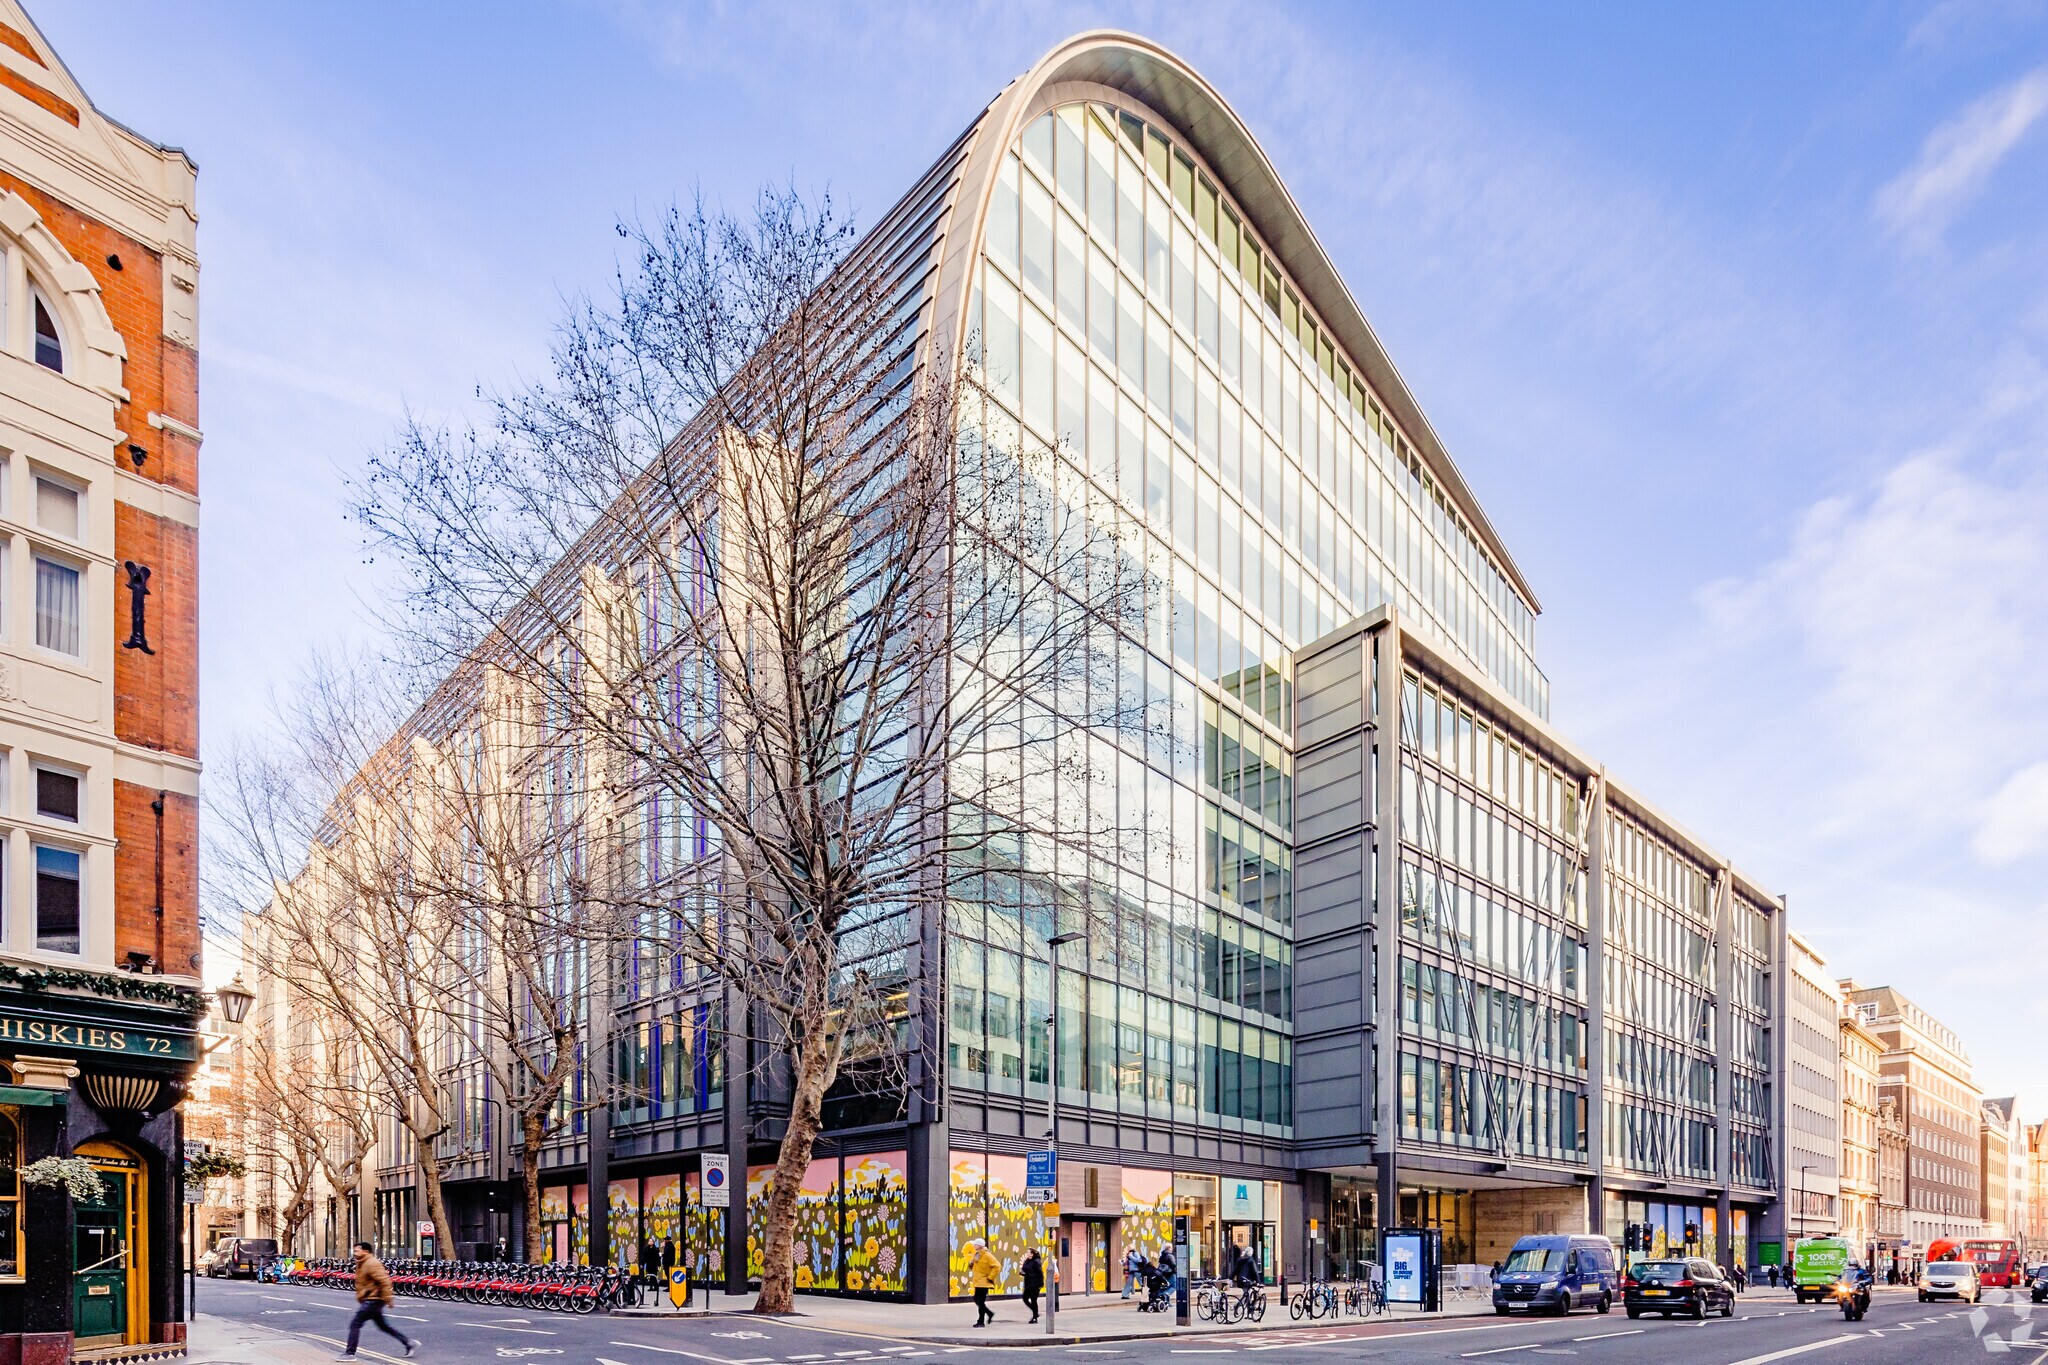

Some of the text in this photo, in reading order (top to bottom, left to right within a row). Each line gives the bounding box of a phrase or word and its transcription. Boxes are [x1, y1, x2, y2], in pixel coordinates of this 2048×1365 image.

[145, 1037, 172, 1053] 72
[1807, 1253, 1836, 1261] 100%
[1394, 1261, 1407, 1270] BIG
